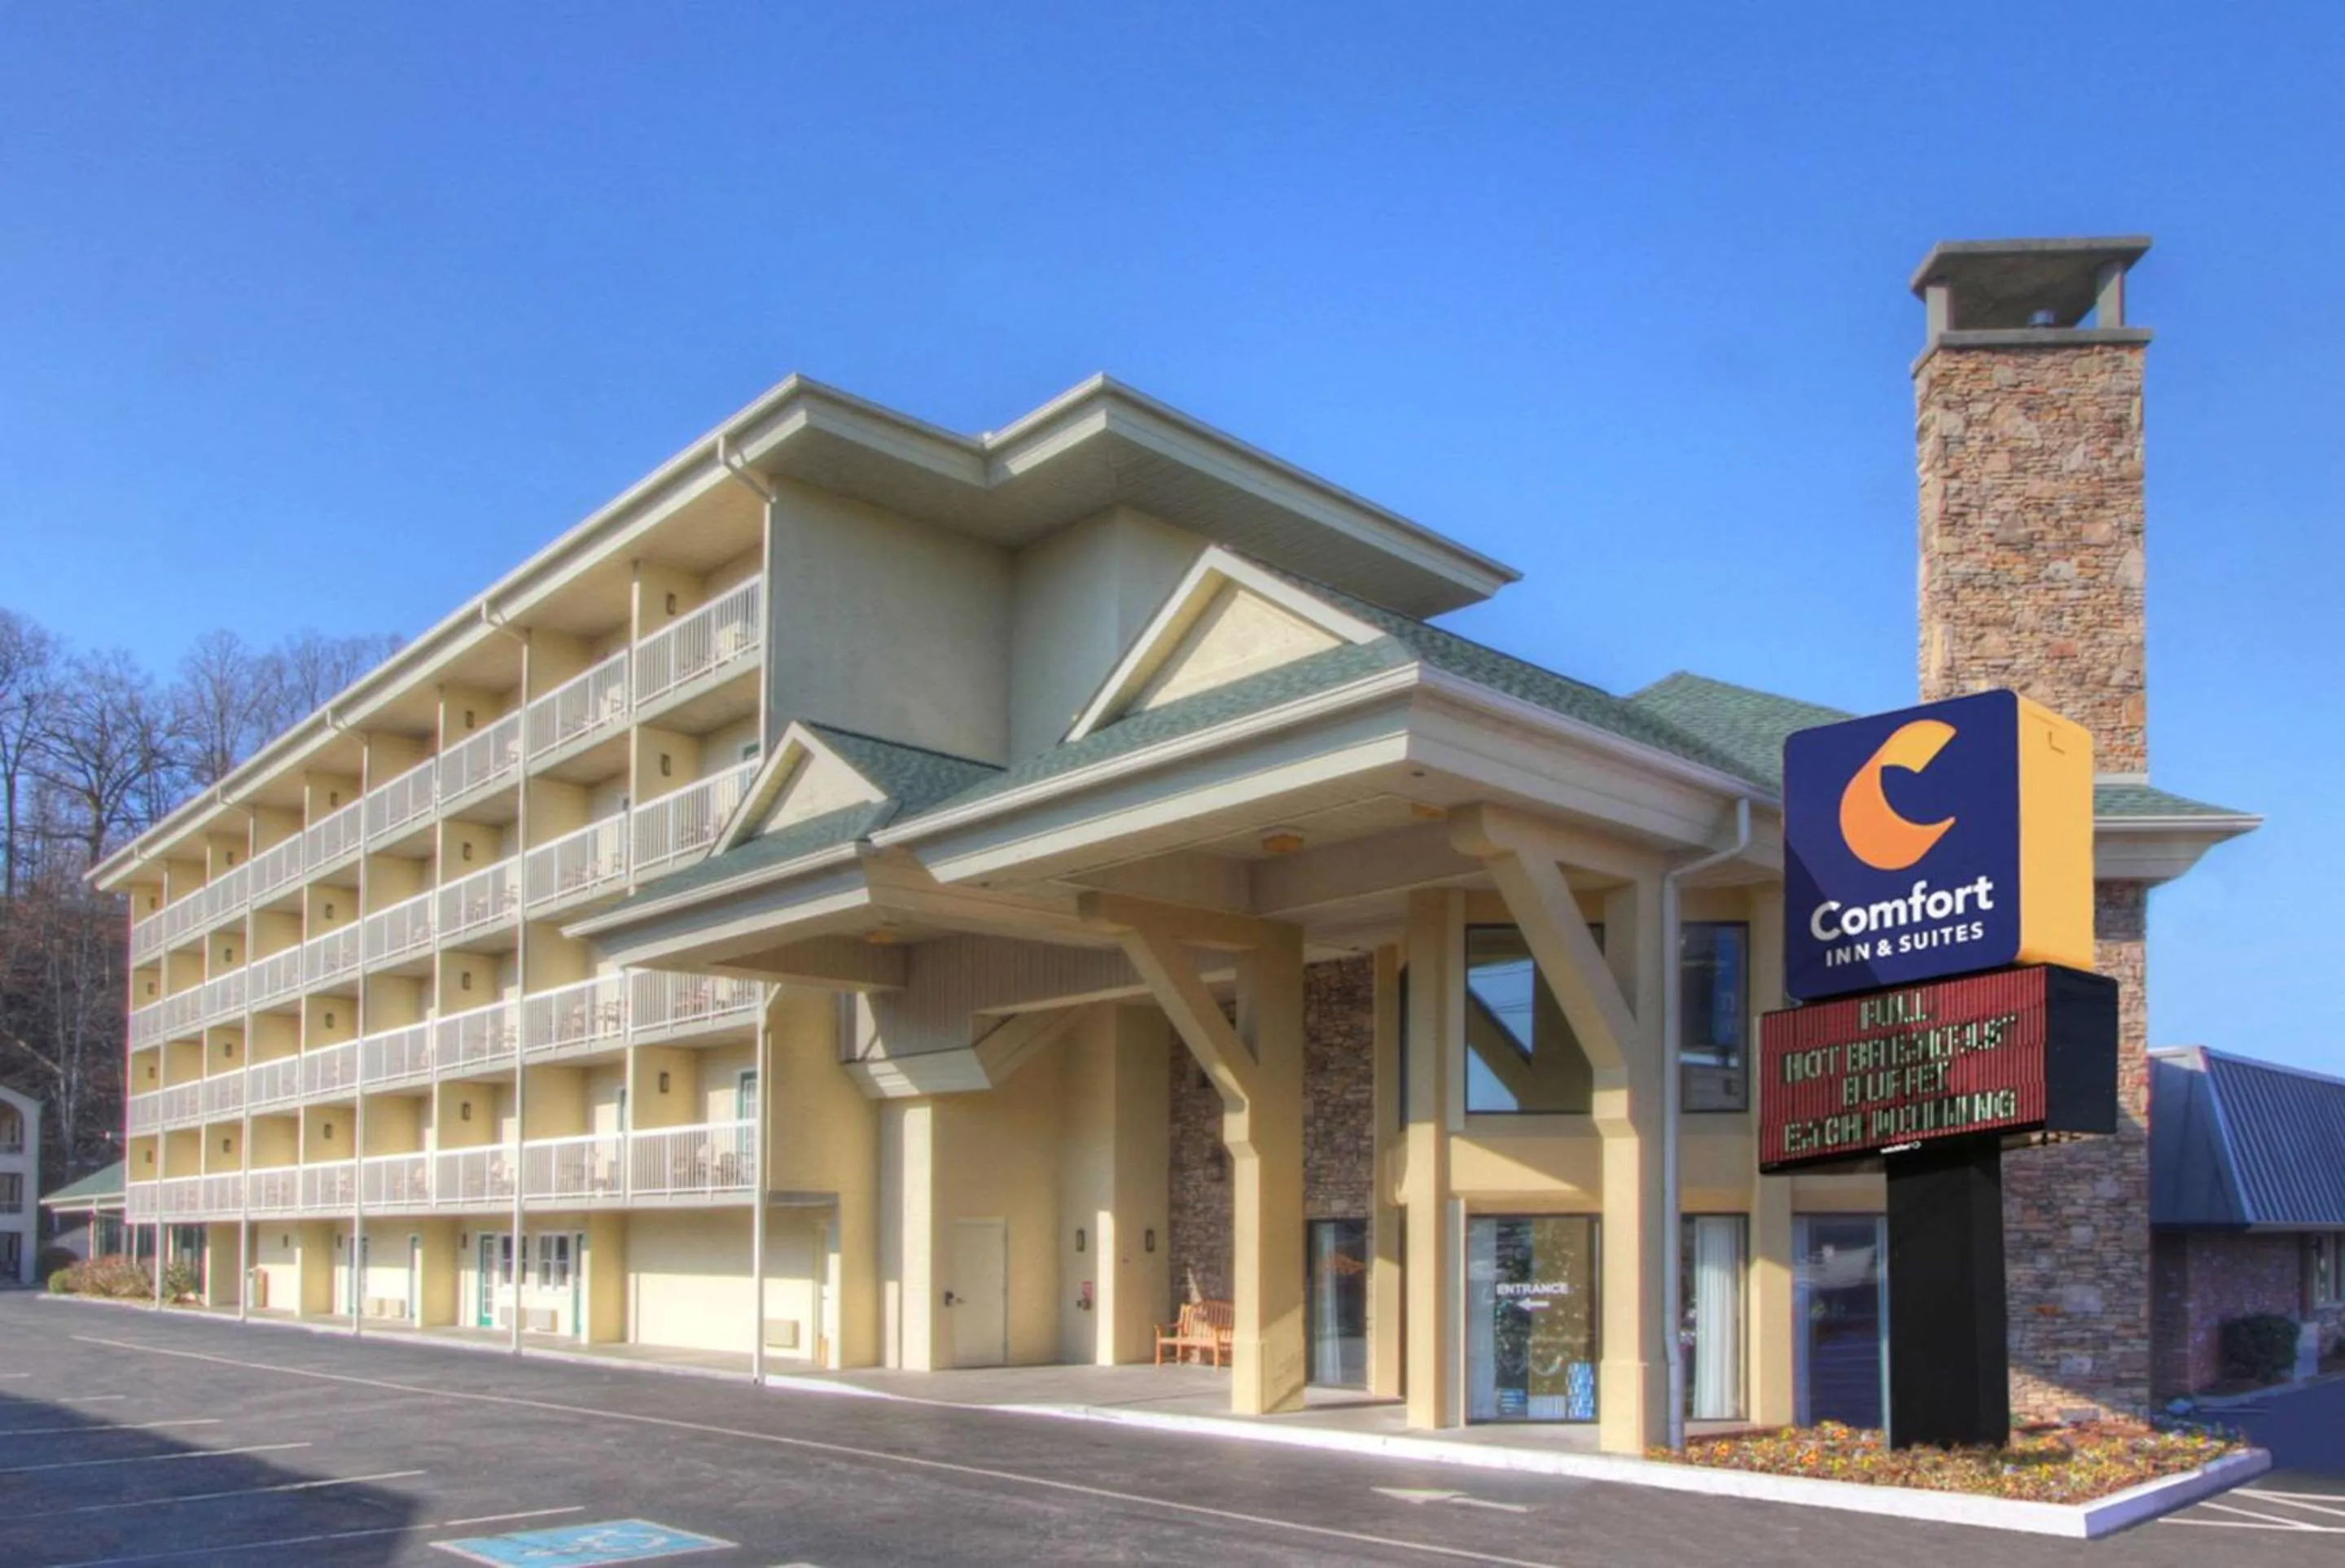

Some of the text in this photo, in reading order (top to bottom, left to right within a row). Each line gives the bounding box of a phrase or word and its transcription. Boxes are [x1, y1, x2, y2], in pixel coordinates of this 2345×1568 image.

[1810, 875, 1994, 942] Comfort
[1826, 921, 1985, 967] INN & SUITES
[1786, 1044, 1841, 1084] HOT
[1843, 1060, 1952, 1106] BUFFET
[1785, 1113, 1863, 1153] EACH
[1496, 1281, 1569, 1295] ENTRANCE
